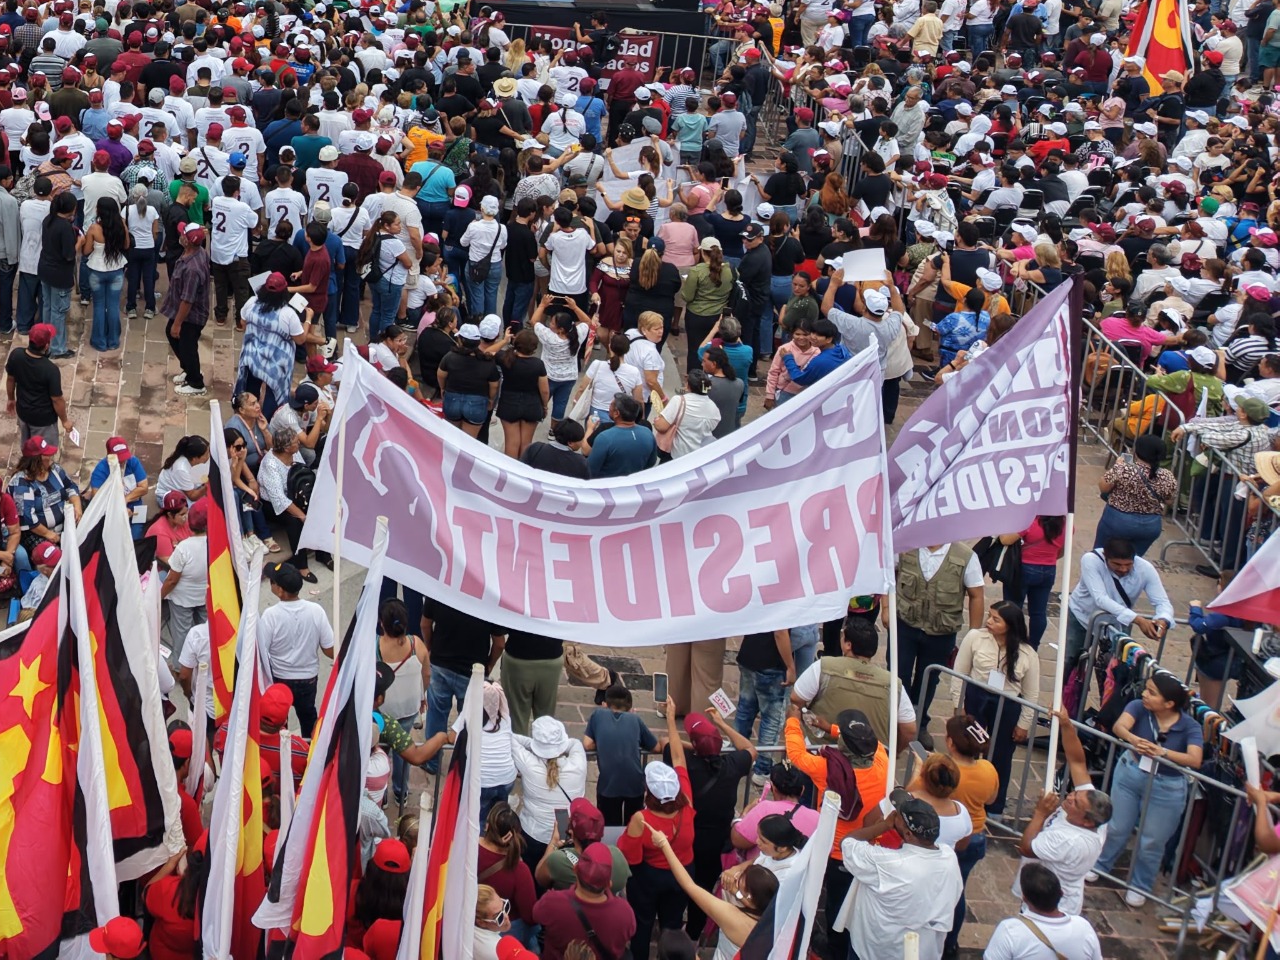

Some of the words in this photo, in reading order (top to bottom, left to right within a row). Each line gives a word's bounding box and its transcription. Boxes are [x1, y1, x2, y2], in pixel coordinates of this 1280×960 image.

[567, 77, 579, 91] 2
[72, 151, 84, 170] 2
[197, 159, 208, 179] 2
[317, 183, 330, 202] 2
[216, 211, 226, 233] 2
